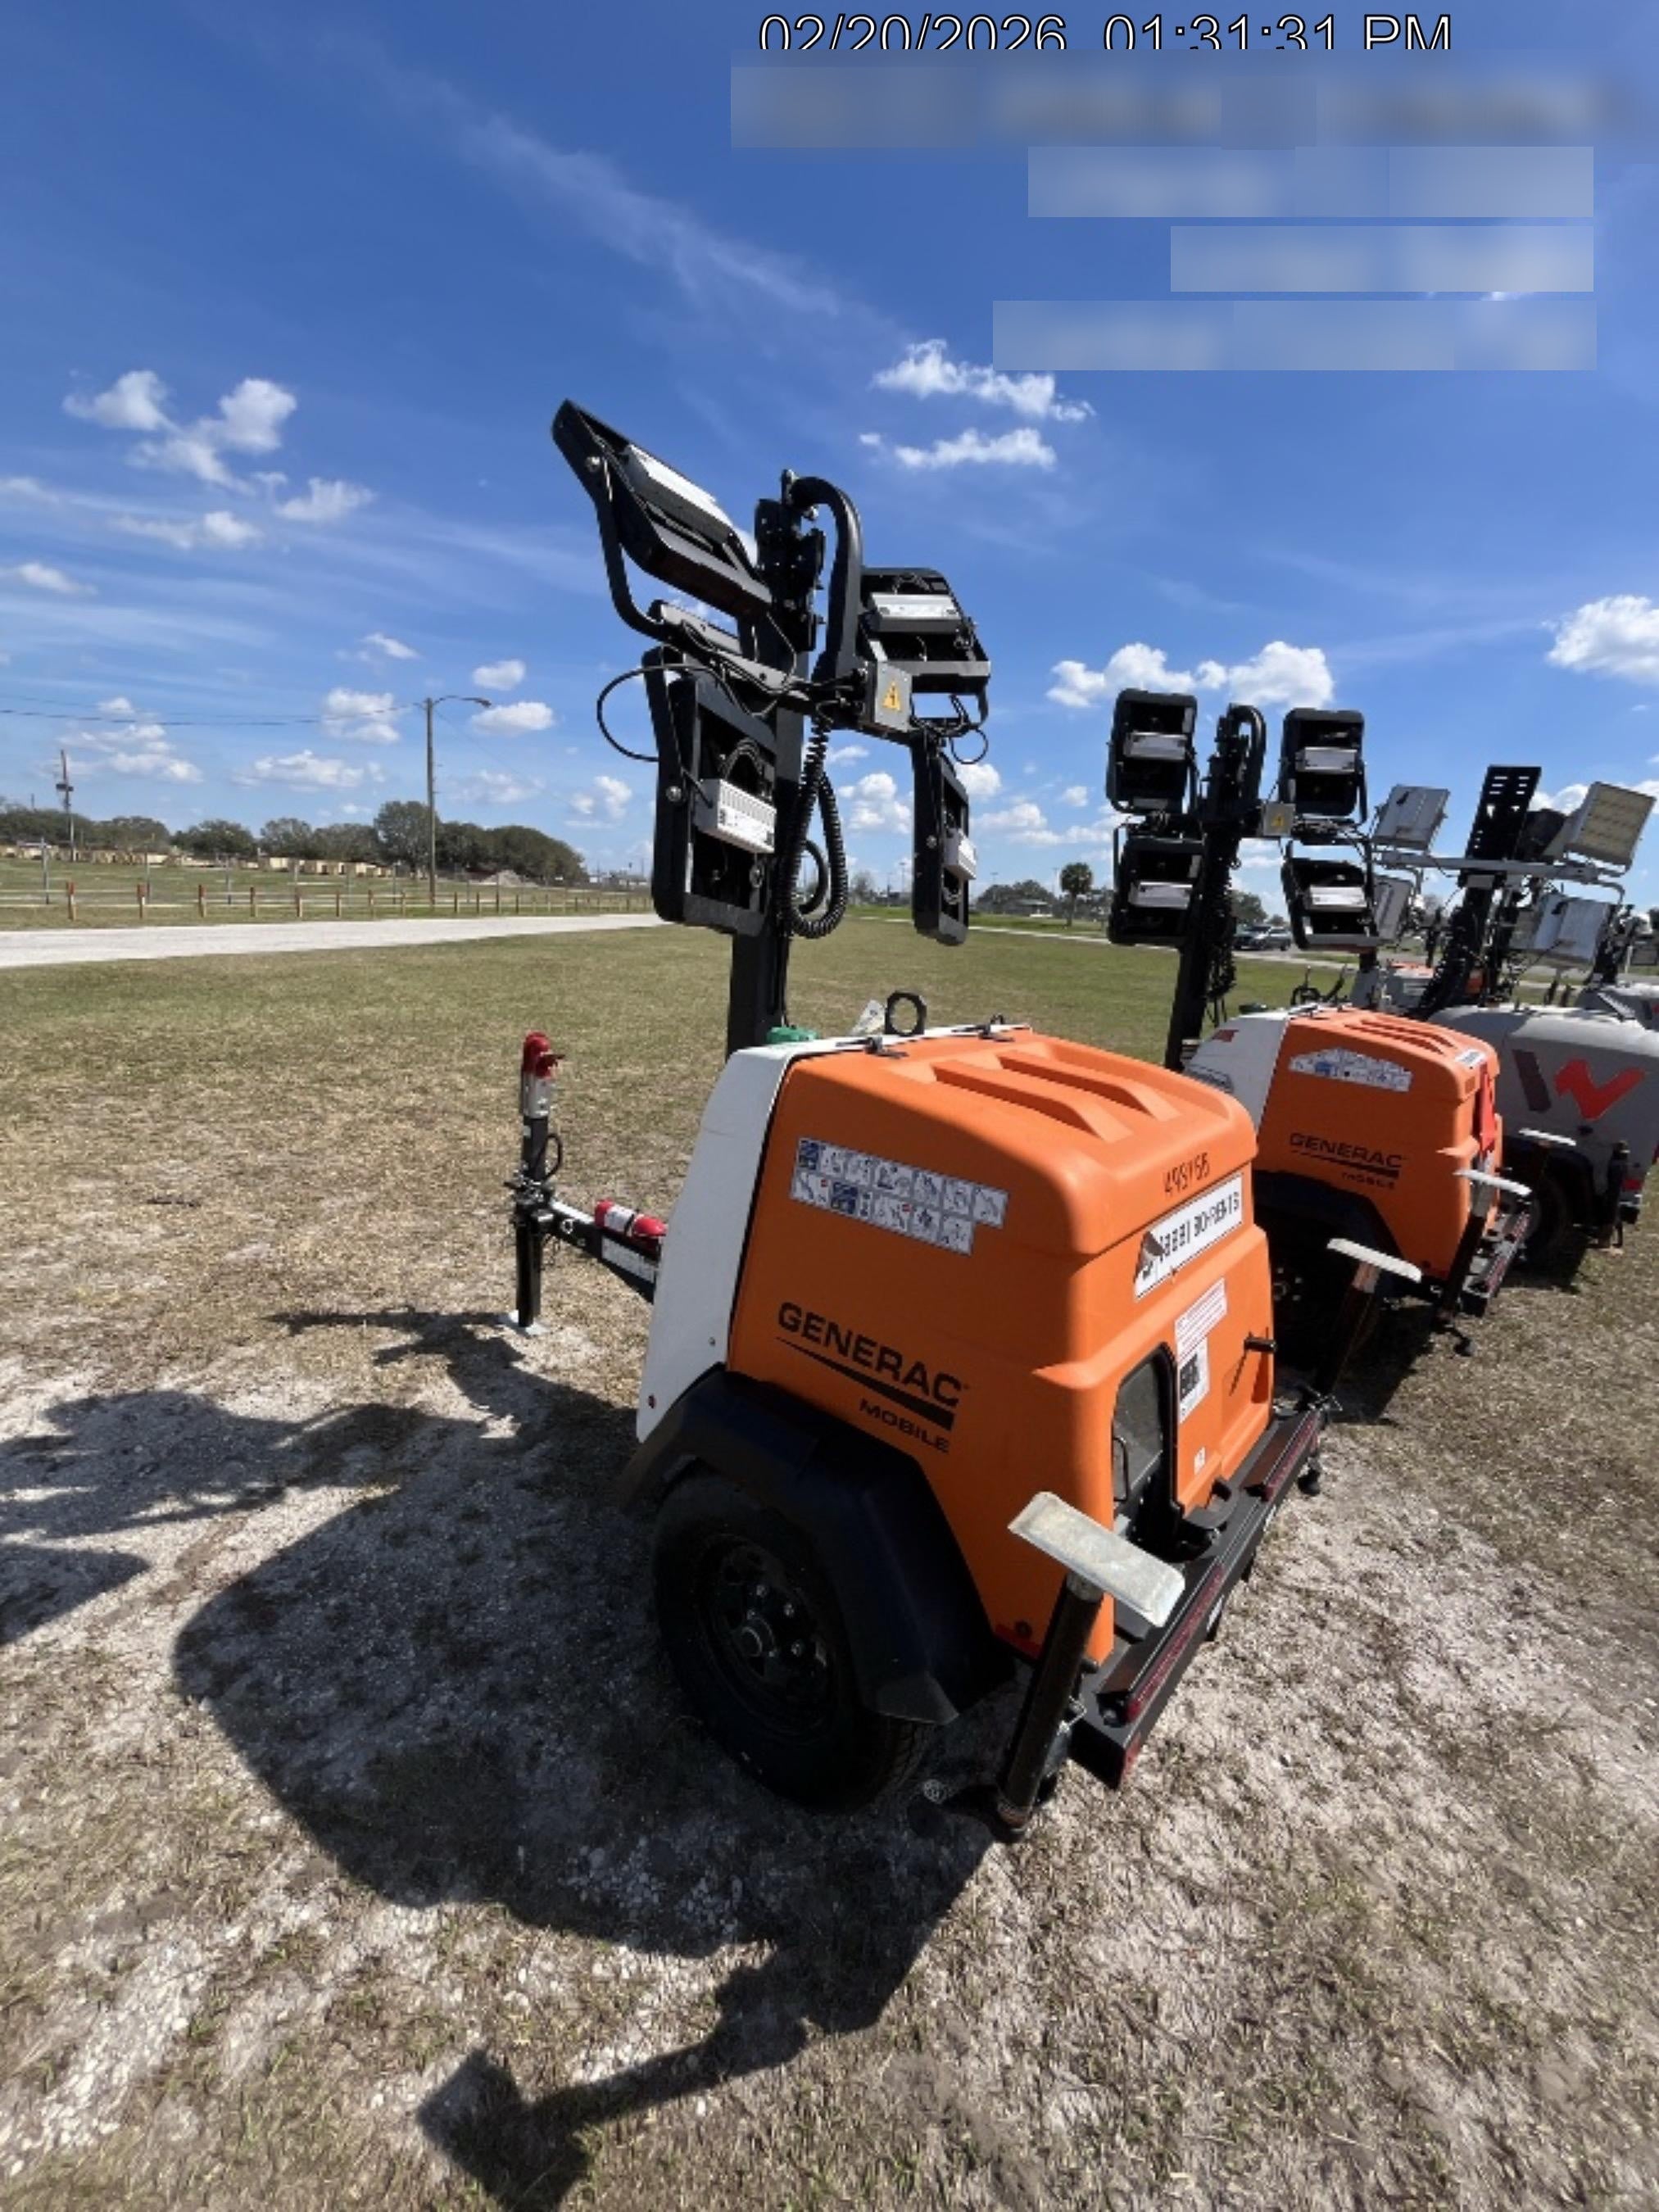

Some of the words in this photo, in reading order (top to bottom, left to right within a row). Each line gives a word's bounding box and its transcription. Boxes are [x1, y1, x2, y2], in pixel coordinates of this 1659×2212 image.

[1290, 1132, 1402, 1168] GENERAC
[778, 1301, 963, 1408] GENERAC
[860, 1398, 949, 1454] MOBILE
